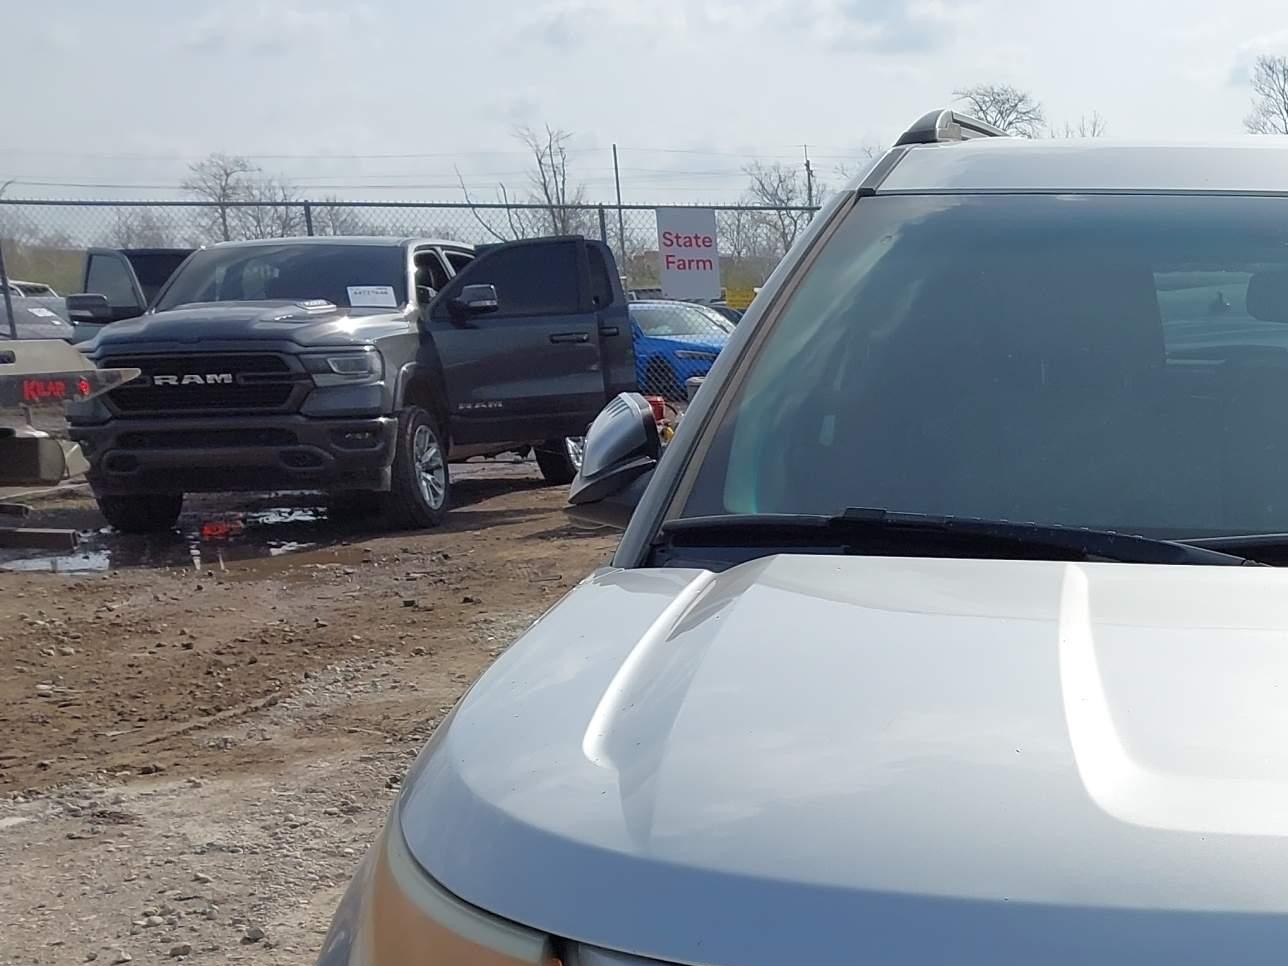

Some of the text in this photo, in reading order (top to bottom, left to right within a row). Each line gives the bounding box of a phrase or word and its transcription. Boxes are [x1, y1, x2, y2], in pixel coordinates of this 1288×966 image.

[662, 231, 713, 248] State
[665, 254, 713, 271] Farm
[153, 373, 233, 386] RAM
